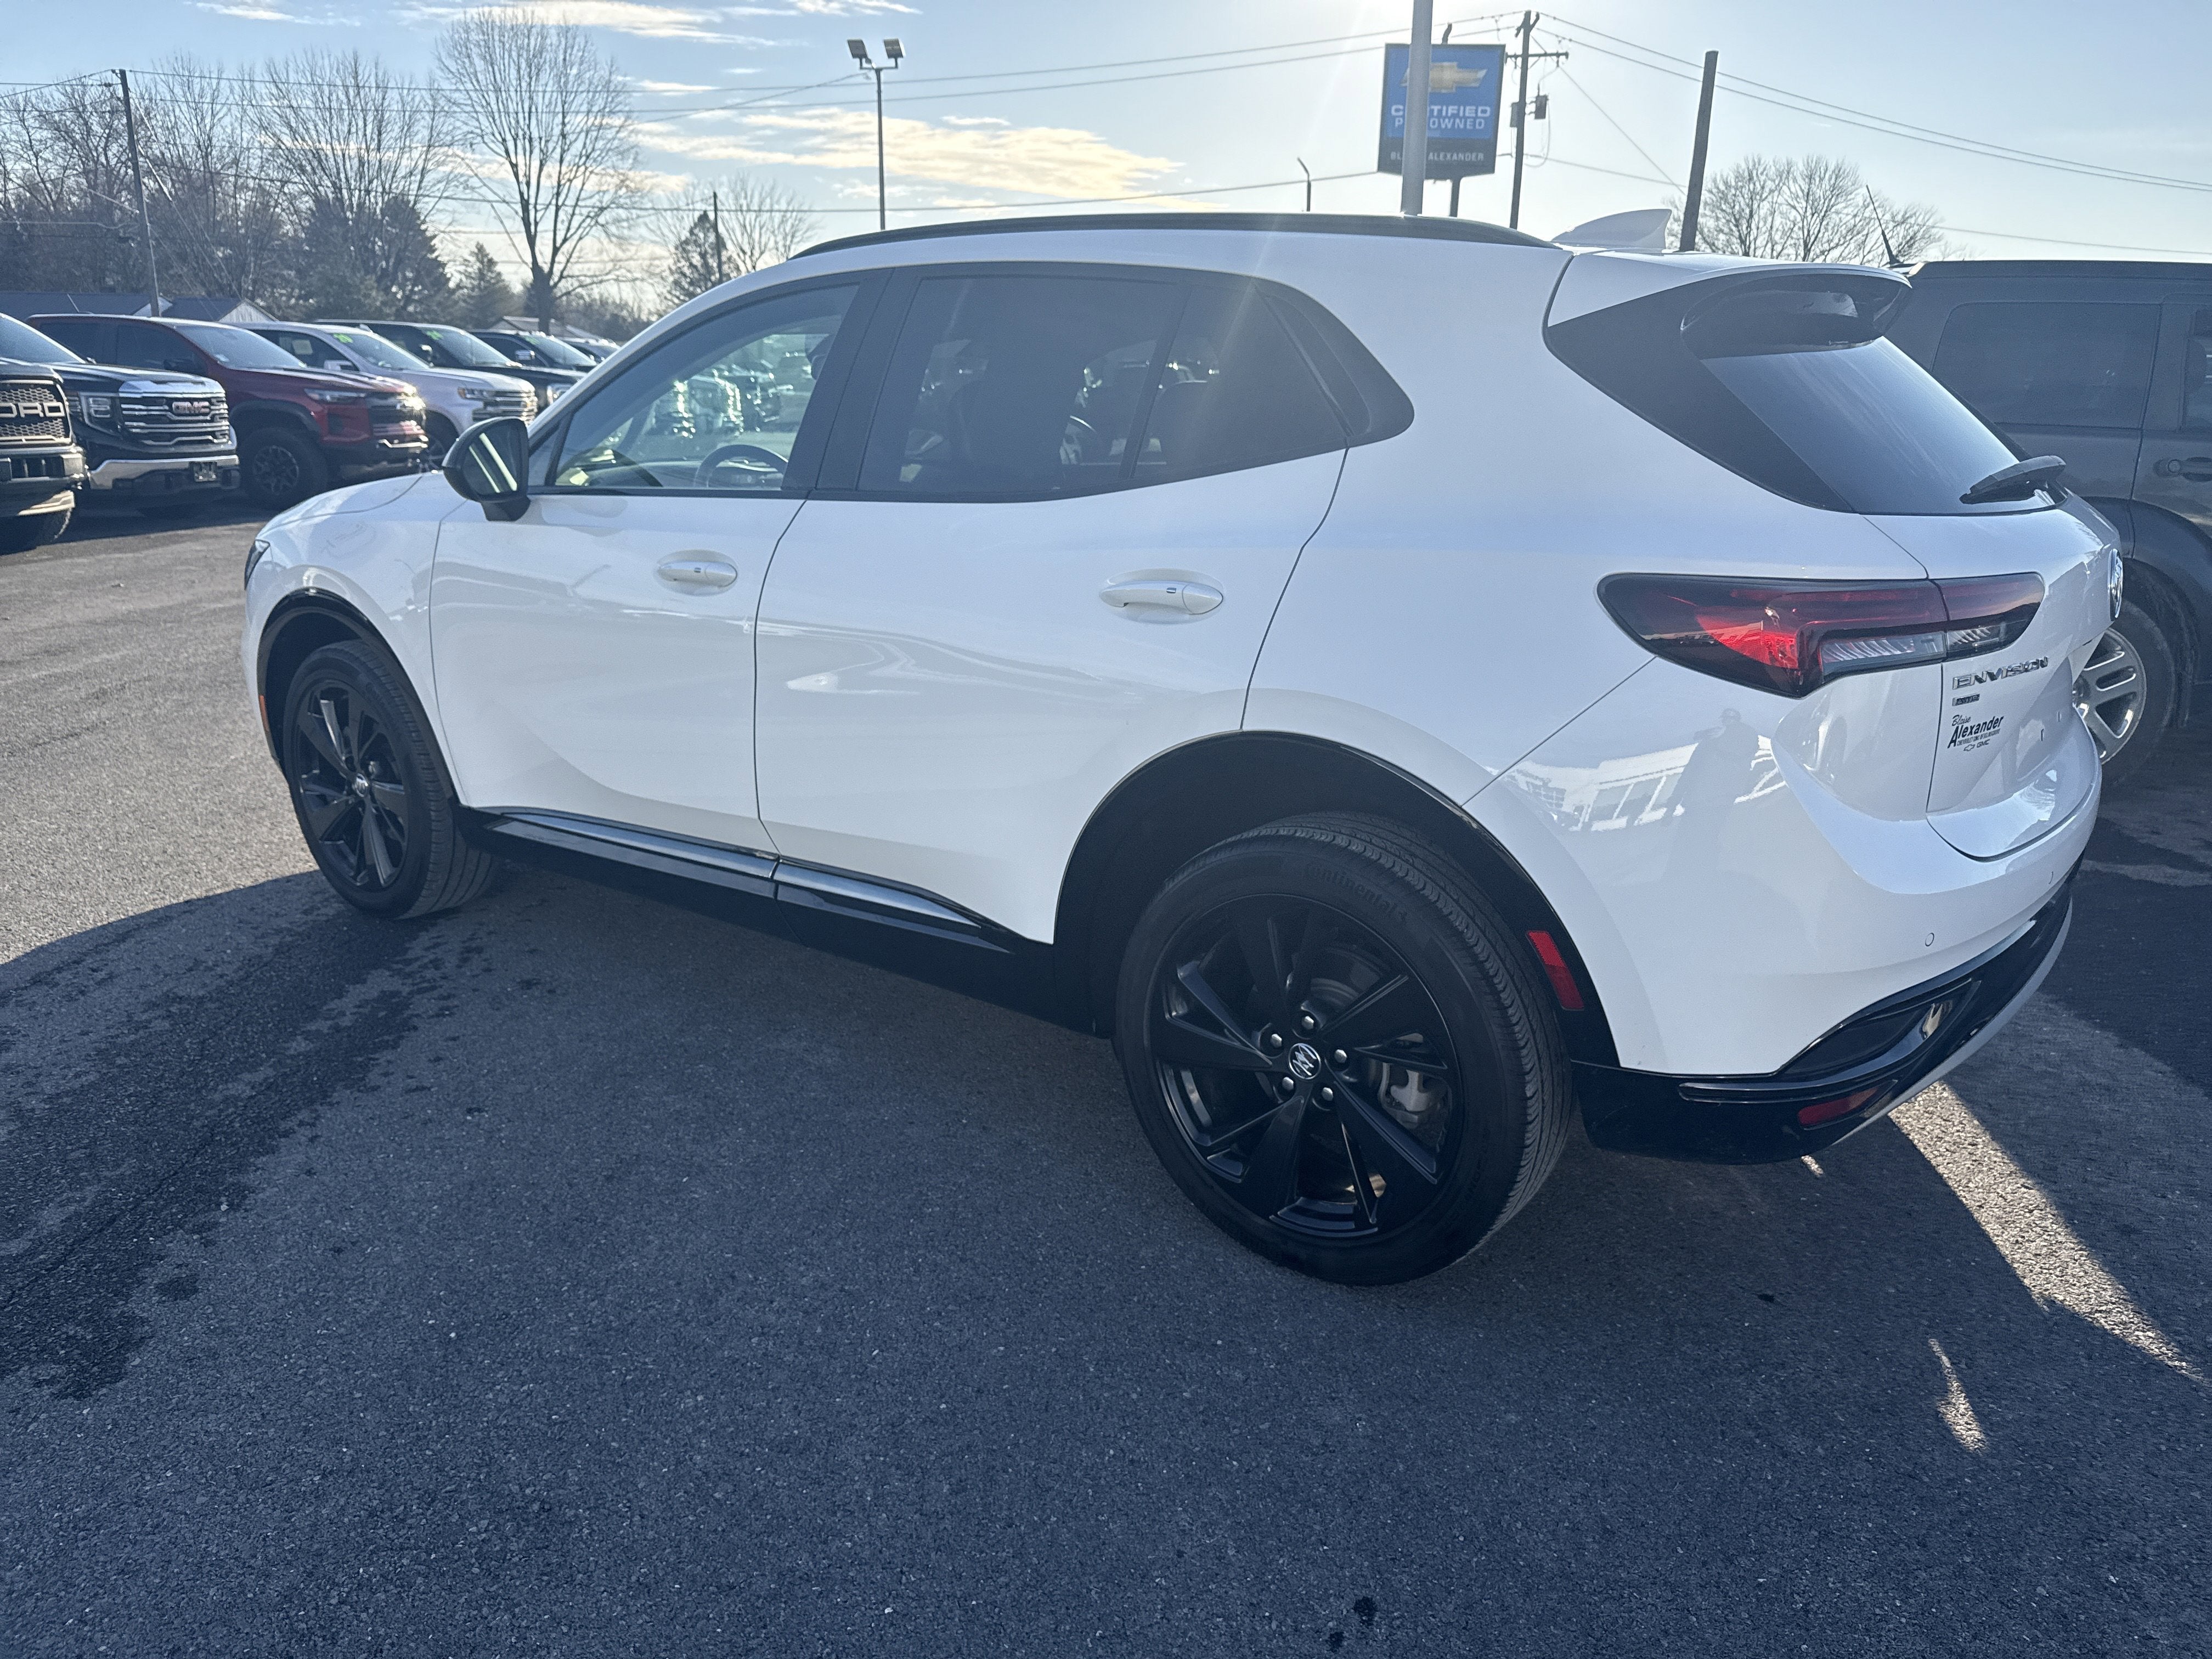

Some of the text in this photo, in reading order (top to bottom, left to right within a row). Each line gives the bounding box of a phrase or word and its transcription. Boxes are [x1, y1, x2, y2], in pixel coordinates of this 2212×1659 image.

[1391, 105, 1491, 117] CTIFIED
[1430, 117, 1485, 129] OWNED
[1428, 151, 1484, 161] ALEXANDER
[0, 402, 65, 417] ORD
[172, 401, 211, 414] GMC
[1952, 656, 2049, 690] ENVISION
[1947, 715, 2004, 749] Alexander
